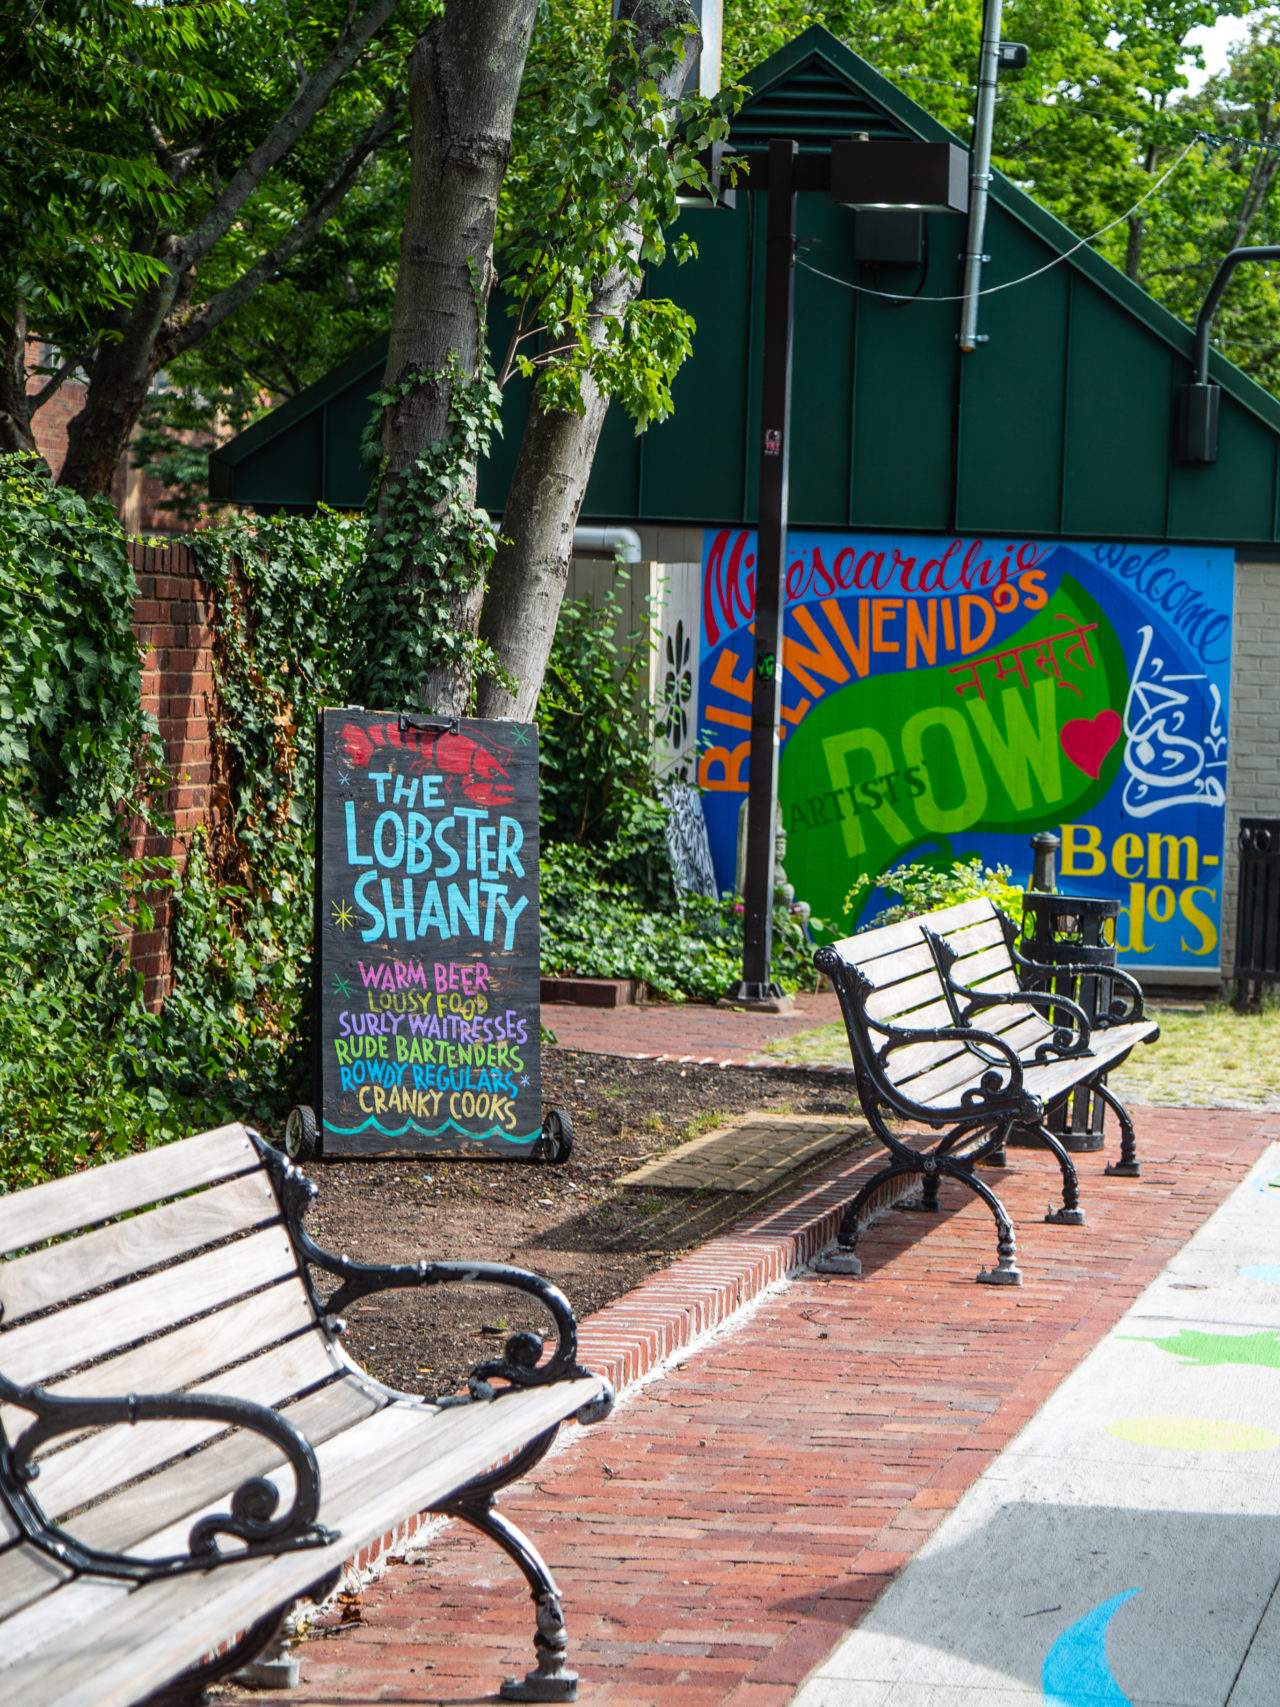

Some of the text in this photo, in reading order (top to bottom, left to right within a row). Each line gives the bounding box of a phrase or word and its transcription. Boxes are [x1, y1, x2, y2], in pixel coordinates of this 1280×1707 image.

[822, 677, 1063, 858] ROW
[368, 772, 445, 809] THE
[345, 801, 526, 880] LOBSTER
[1059, 824, 1219, 881] Bem-
[354, 870, 529, 951] SHANTY
[358, 960, 489, 996] WARM BEER
[367, 989, 488, 1021] LOUSY FOOD
[339, 1009, 528, 1044] SURLY WAITRESSES
[335, 1035, 524, 1073] RUDE BARTENDERS
[340, 1058, 519, 1099] ROWDY REGULARS
[359, 1085, 517, 1129] CRANKY COOKS
